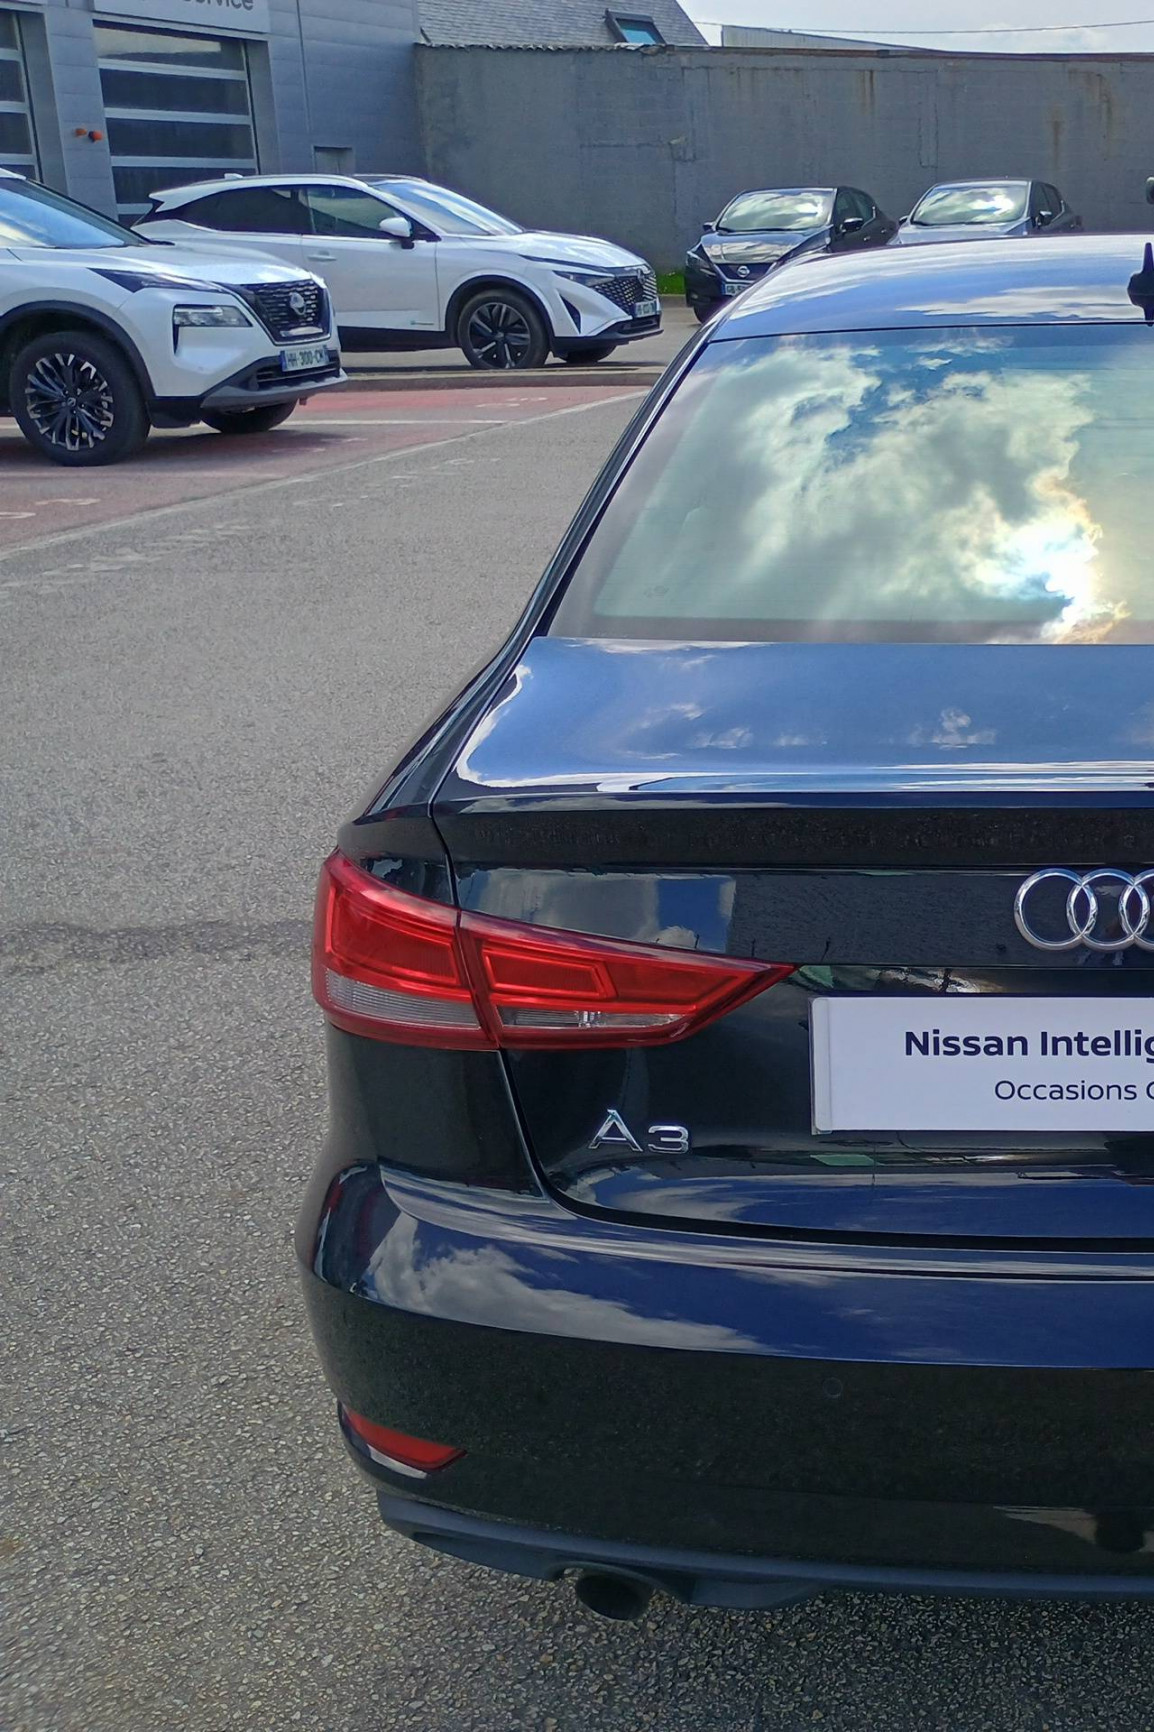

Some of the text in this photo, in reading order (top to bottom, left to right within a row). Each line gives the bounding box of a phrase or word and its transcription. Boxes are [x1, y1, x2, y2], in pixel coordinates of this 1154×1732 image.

[904, 1029, 1029, 1057] Nissan
[994, 1080, 1138, 1101] Occasions
[588, 1109, 690, 1154] A3
